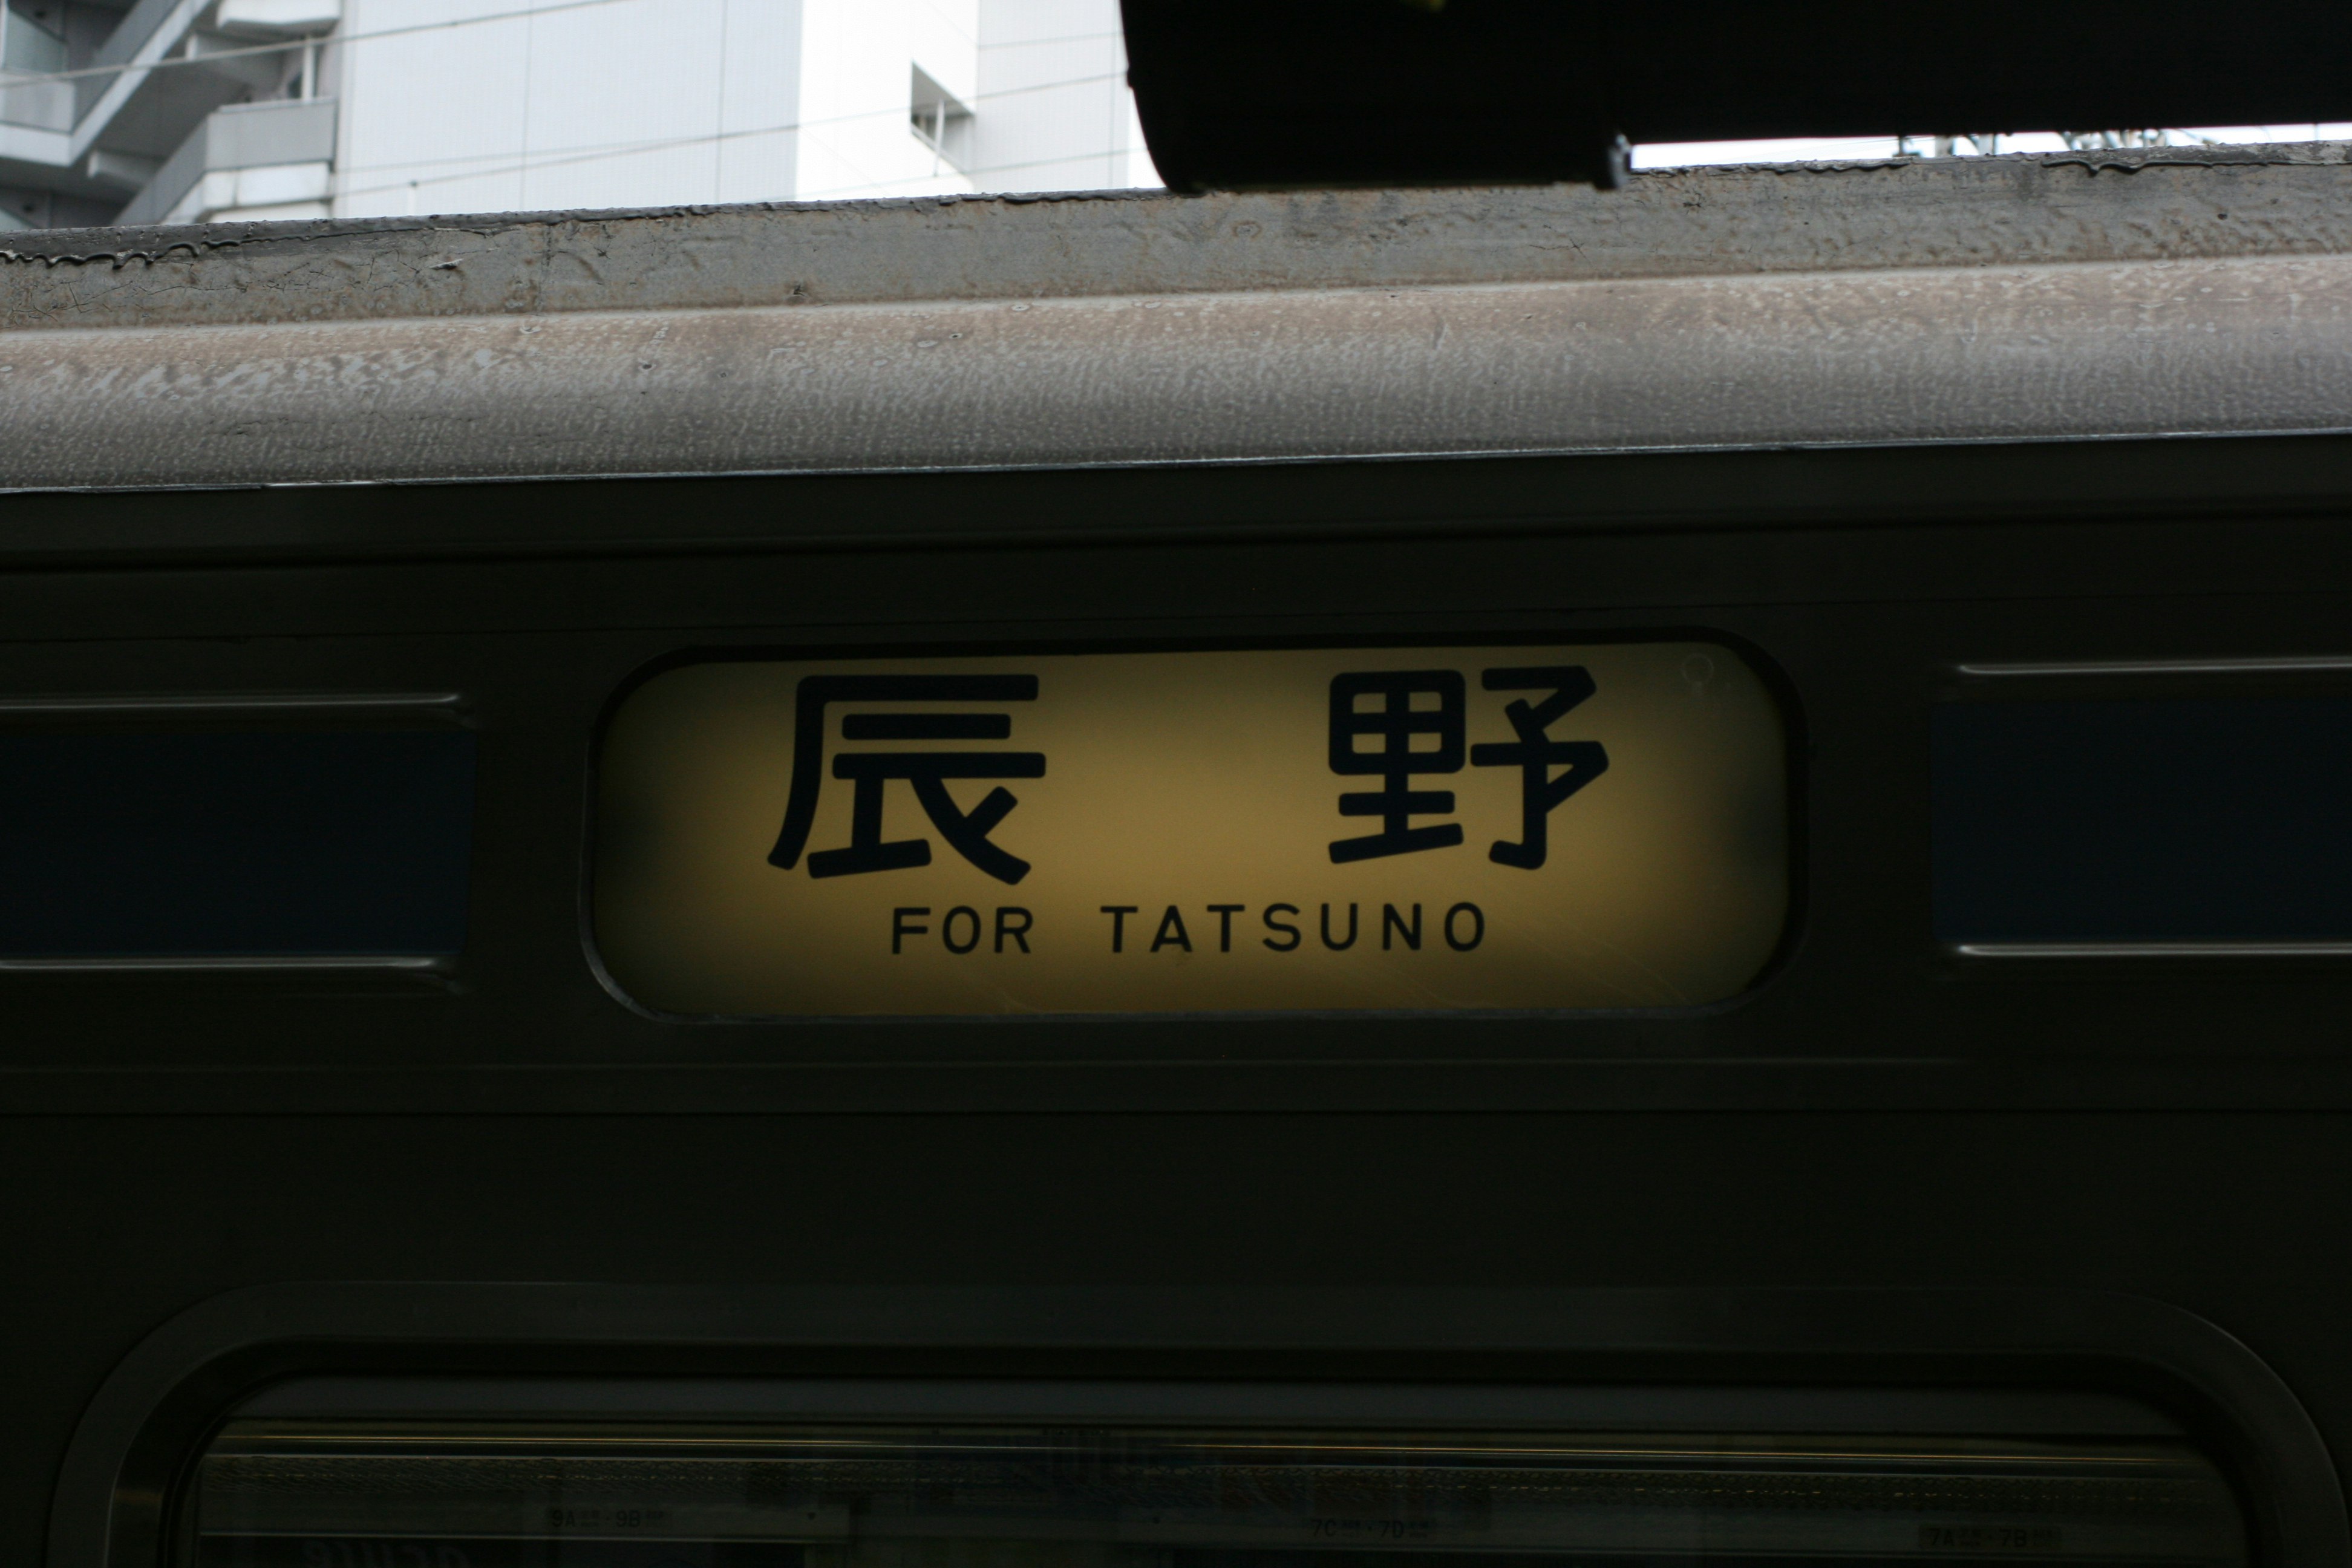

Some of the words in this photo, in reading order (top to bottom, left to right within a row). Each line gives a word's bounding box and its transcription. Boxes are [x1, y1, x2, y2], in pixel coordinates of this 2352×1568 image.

[767, 665, 1609, 885] 辰野
[892, 906, 1033, 955] FOR
[1100, 902, 1485, 954] TATSUNO
[551, 1509, 576, 1527] 9A
[615, 1509, 641, 1528] 9B
[1310, 1518, 1337, 1537] 7C
[1928, 1527, 1955, 1546] 7A
[1999, 1528, 2028, 1547] 7B
